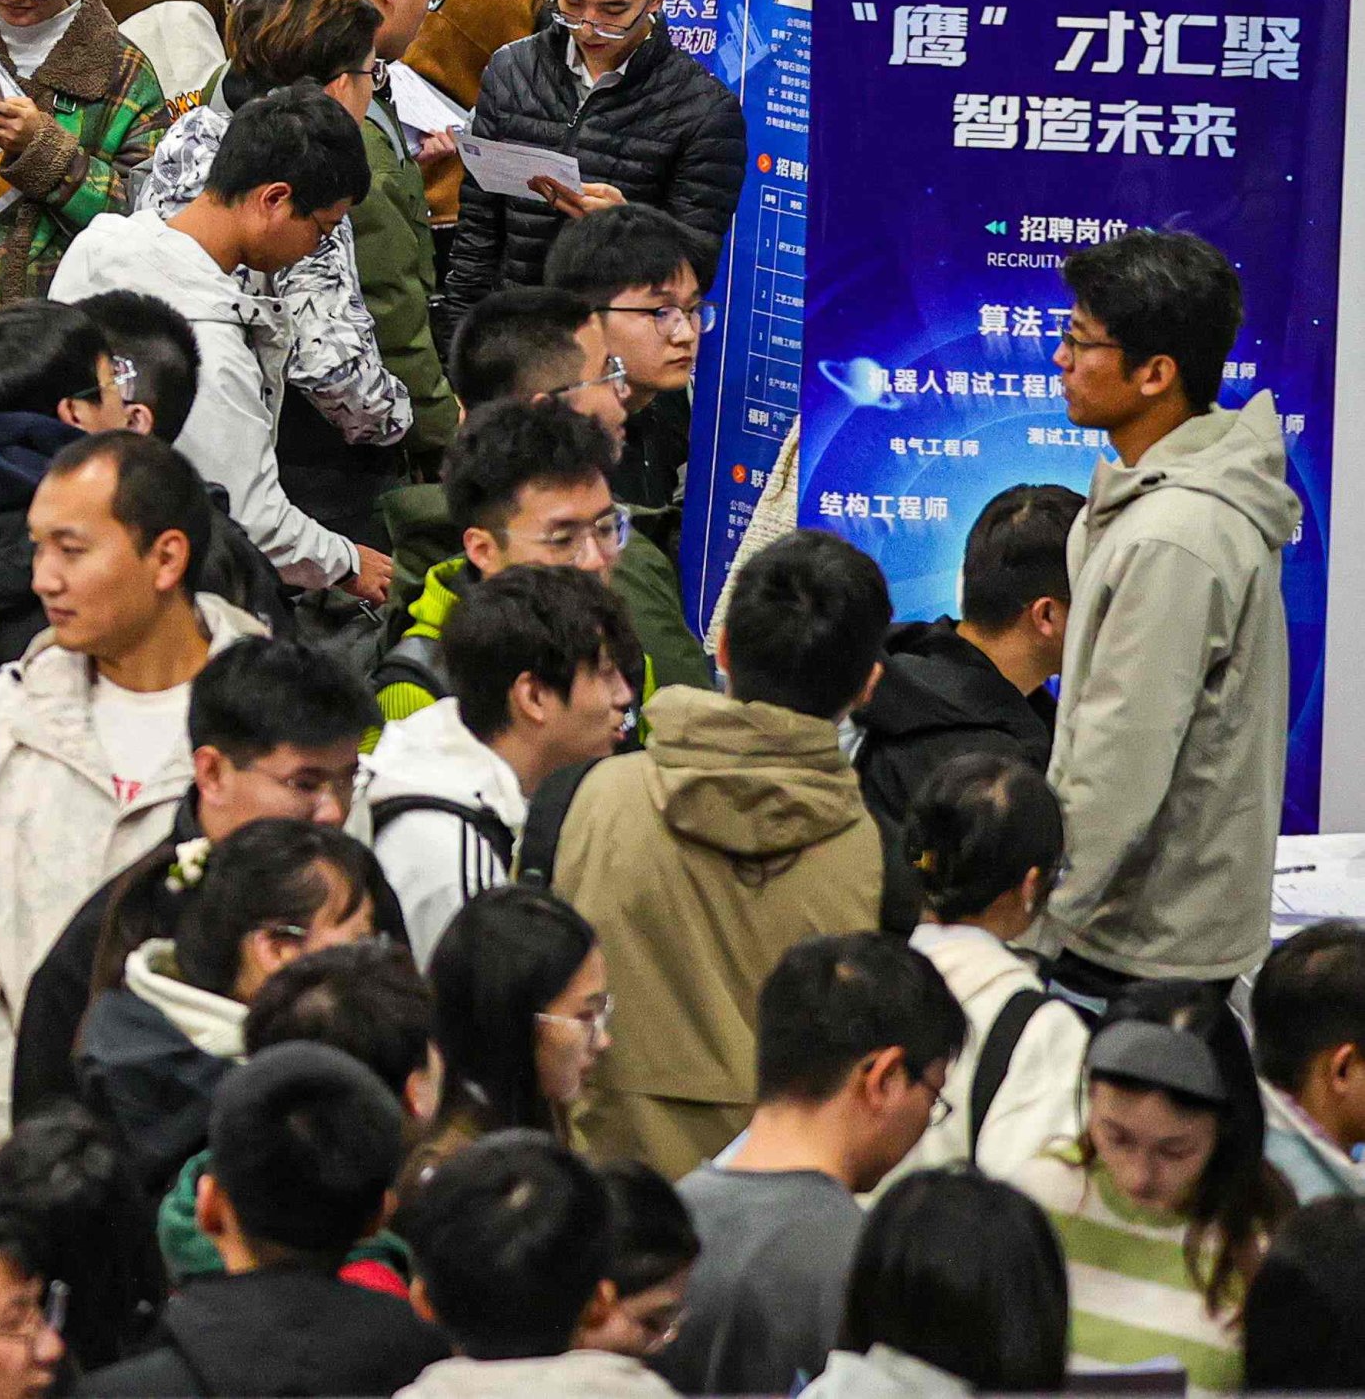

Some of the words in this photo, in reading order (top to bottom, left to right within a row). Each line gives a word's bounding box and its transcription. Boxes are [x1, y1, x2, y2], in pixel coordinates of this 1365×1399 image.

[1055, 10, 1301, 81] 才汇聚
[953, 93, 1236, 159] 智造未来
[1019, 216, 1130, 245] 招聘岗位
[748, 408, 769, 427] 福利
[889, 436, 979, 457] 电气工程师
[819, 491, 948, 521] 结构工程师
